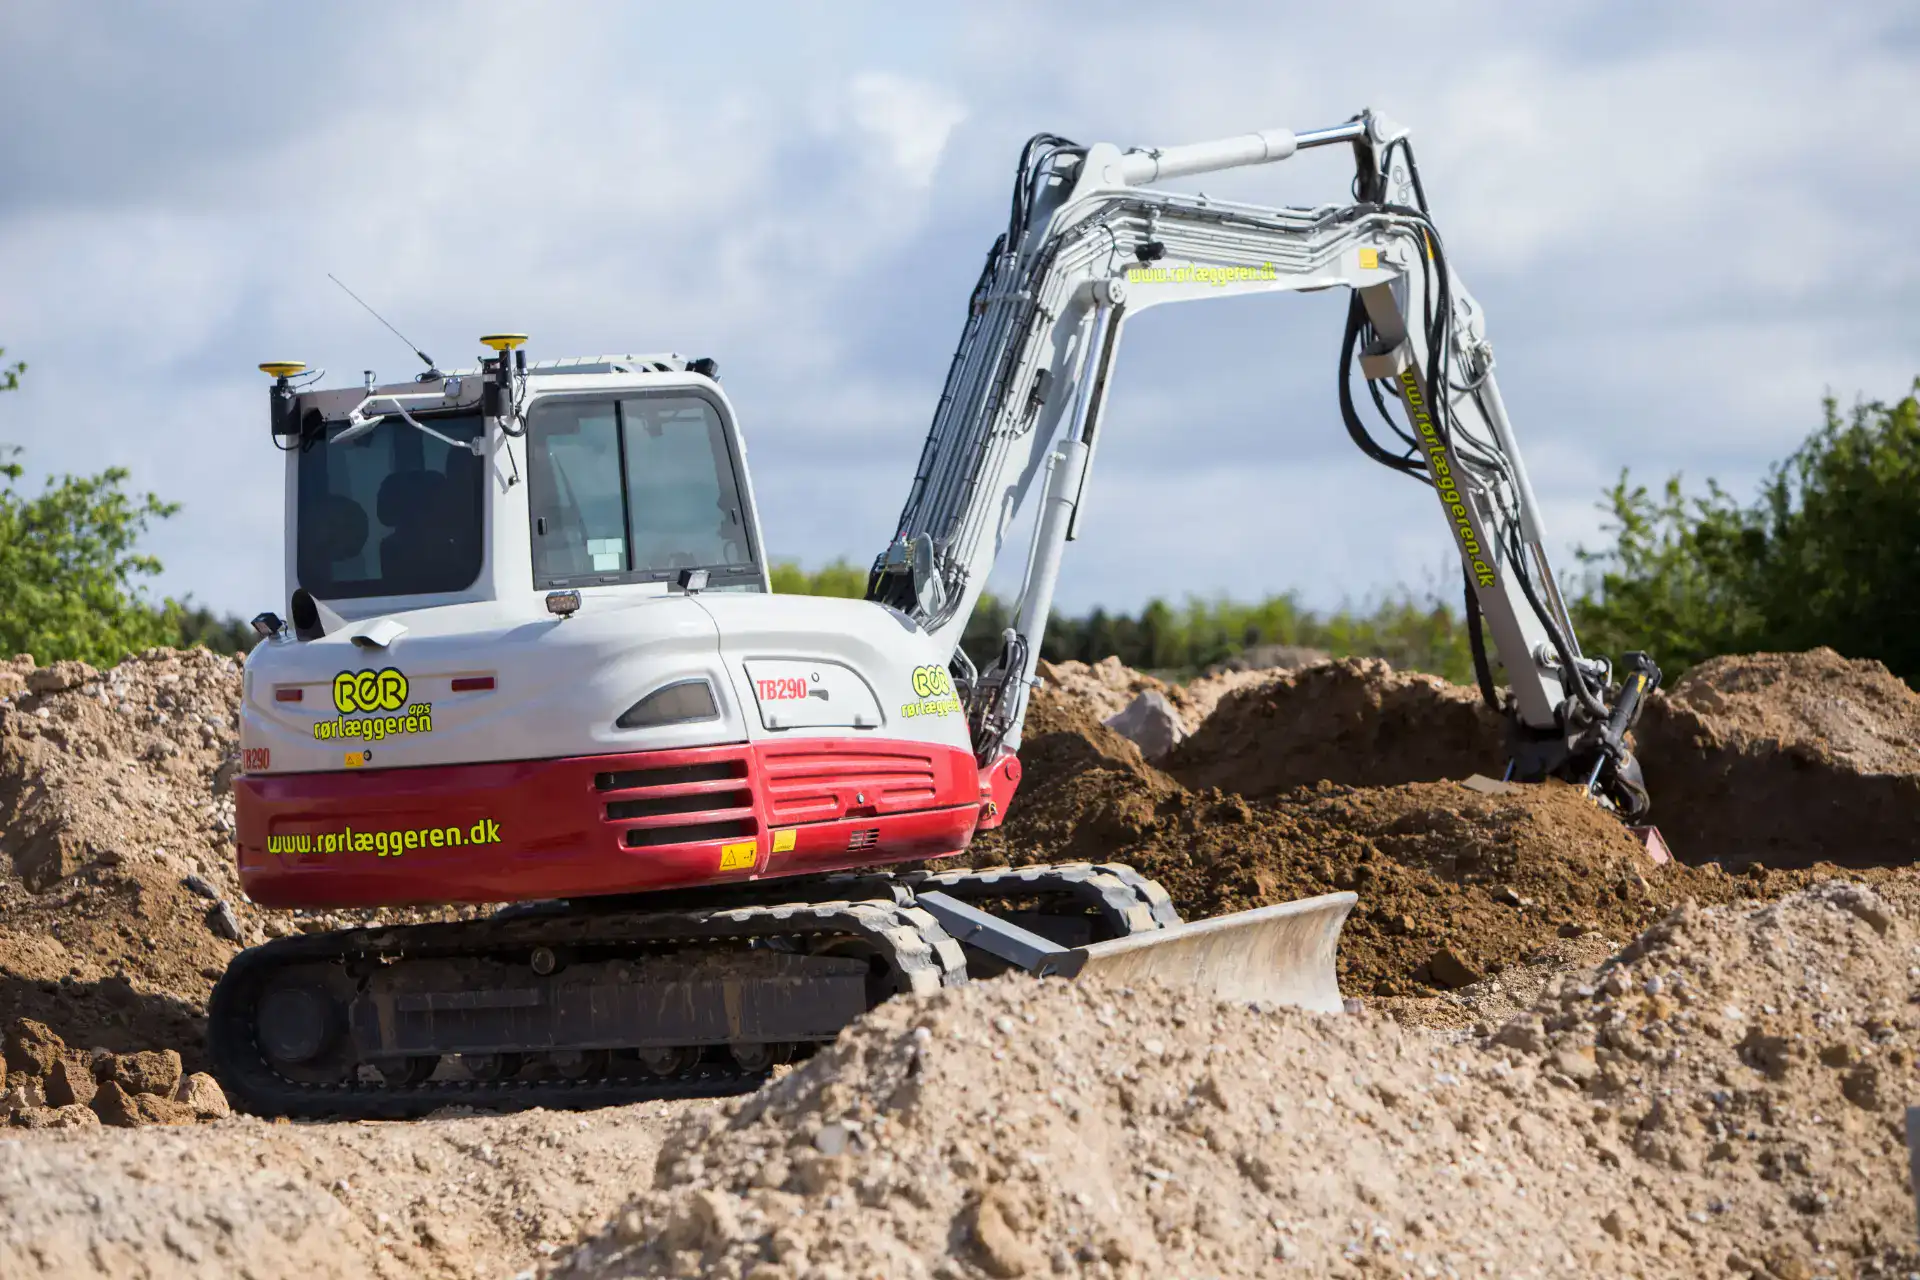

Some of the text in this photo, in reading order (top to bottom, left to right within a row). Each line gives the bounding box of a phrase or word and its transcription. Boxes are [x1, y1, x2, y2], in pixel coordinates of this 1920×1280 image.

[1128, 261, 1277, 285] www.rørlæggeren.dk
[1400, 366, 1495, 588] ww.rørlæggeren.dk
[333, 667, 409, 714] RØR
[757, 678, 807, 700] TB290
[408, 703, 432, 717] aps
[313, 714, 432, 741] rørlæggeren
[267, 819, 501, 857] www.rørlæggeren.dk
